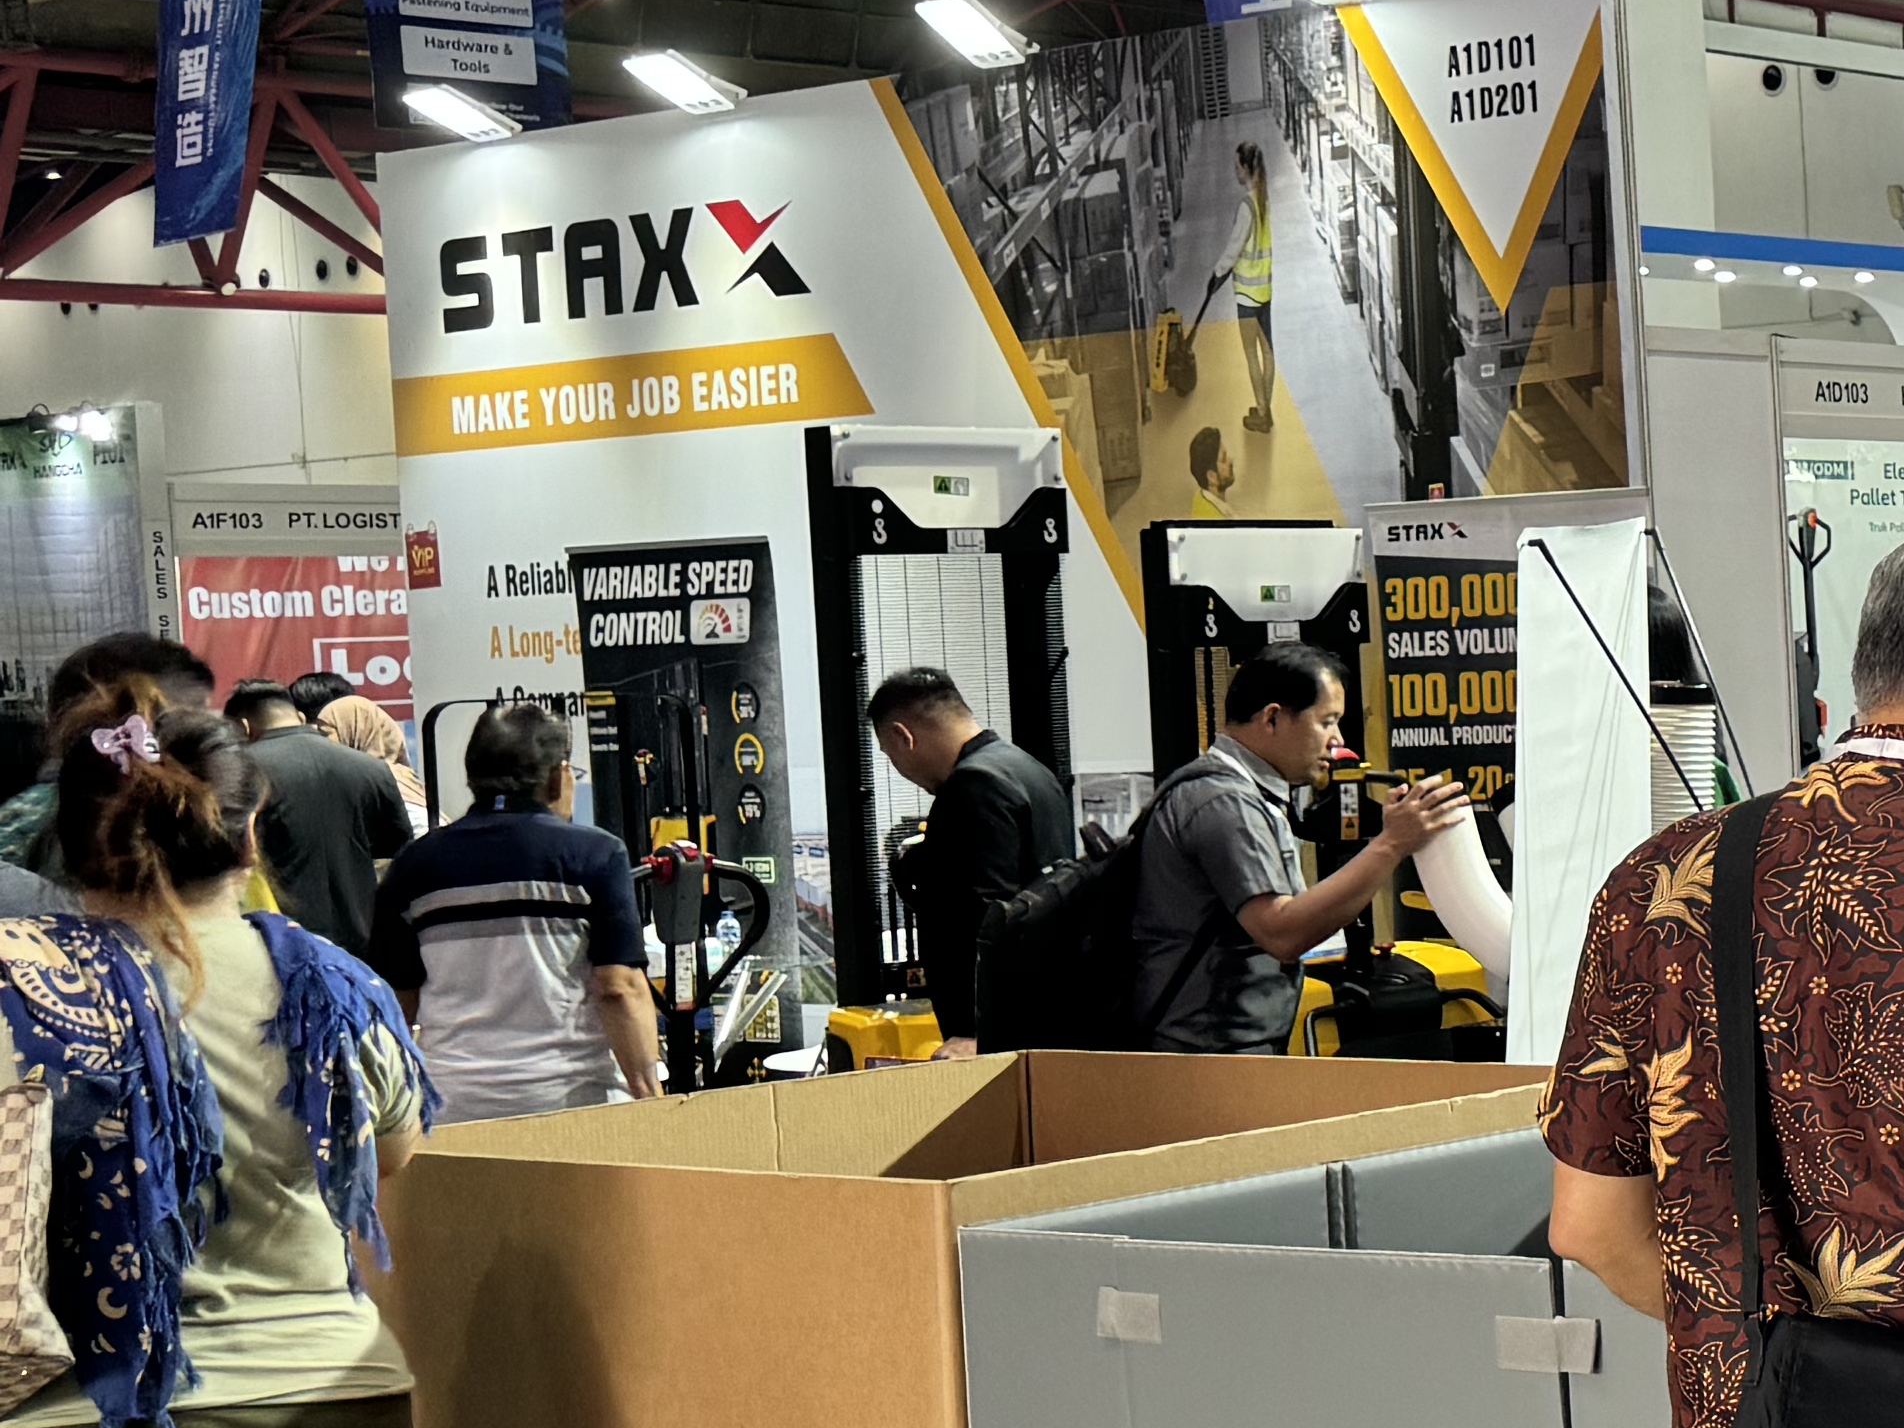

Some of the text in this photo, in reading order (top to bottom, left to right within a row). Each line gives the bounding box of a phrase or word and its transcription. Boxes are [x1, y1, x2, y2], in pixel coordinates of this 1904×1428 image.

[464, 0, 530, 17] Equipment
[424, 35, 513, 57] Hardware &
[1447, 33, 1537, 79] A1D101
[451, 58, 491, 74] Tools
[1449, 80, 1540, 125] A1D201
[451, 364, 800, 436] MAKE YOUR JOB EASIER
[1815, 380, 1869, 404] A1D103
[1850, 489, 1897, 506] Pallet
[192, 512, 400, 529] A1F103 PT. LOGIST
[152, 531, 168, 599] SALES
[487, 565, 499, 598] A
[583, 559, 753, 601] VARIABLE SPEED
[188, 584, 407, 619] Custom Clera
[490, 626, 503, 659] A
[590, 609, 685, 647] CONTROL
[1388, 630, 1449, 658] SALES
[1391, 727, 1449, 747] ANNUAL
